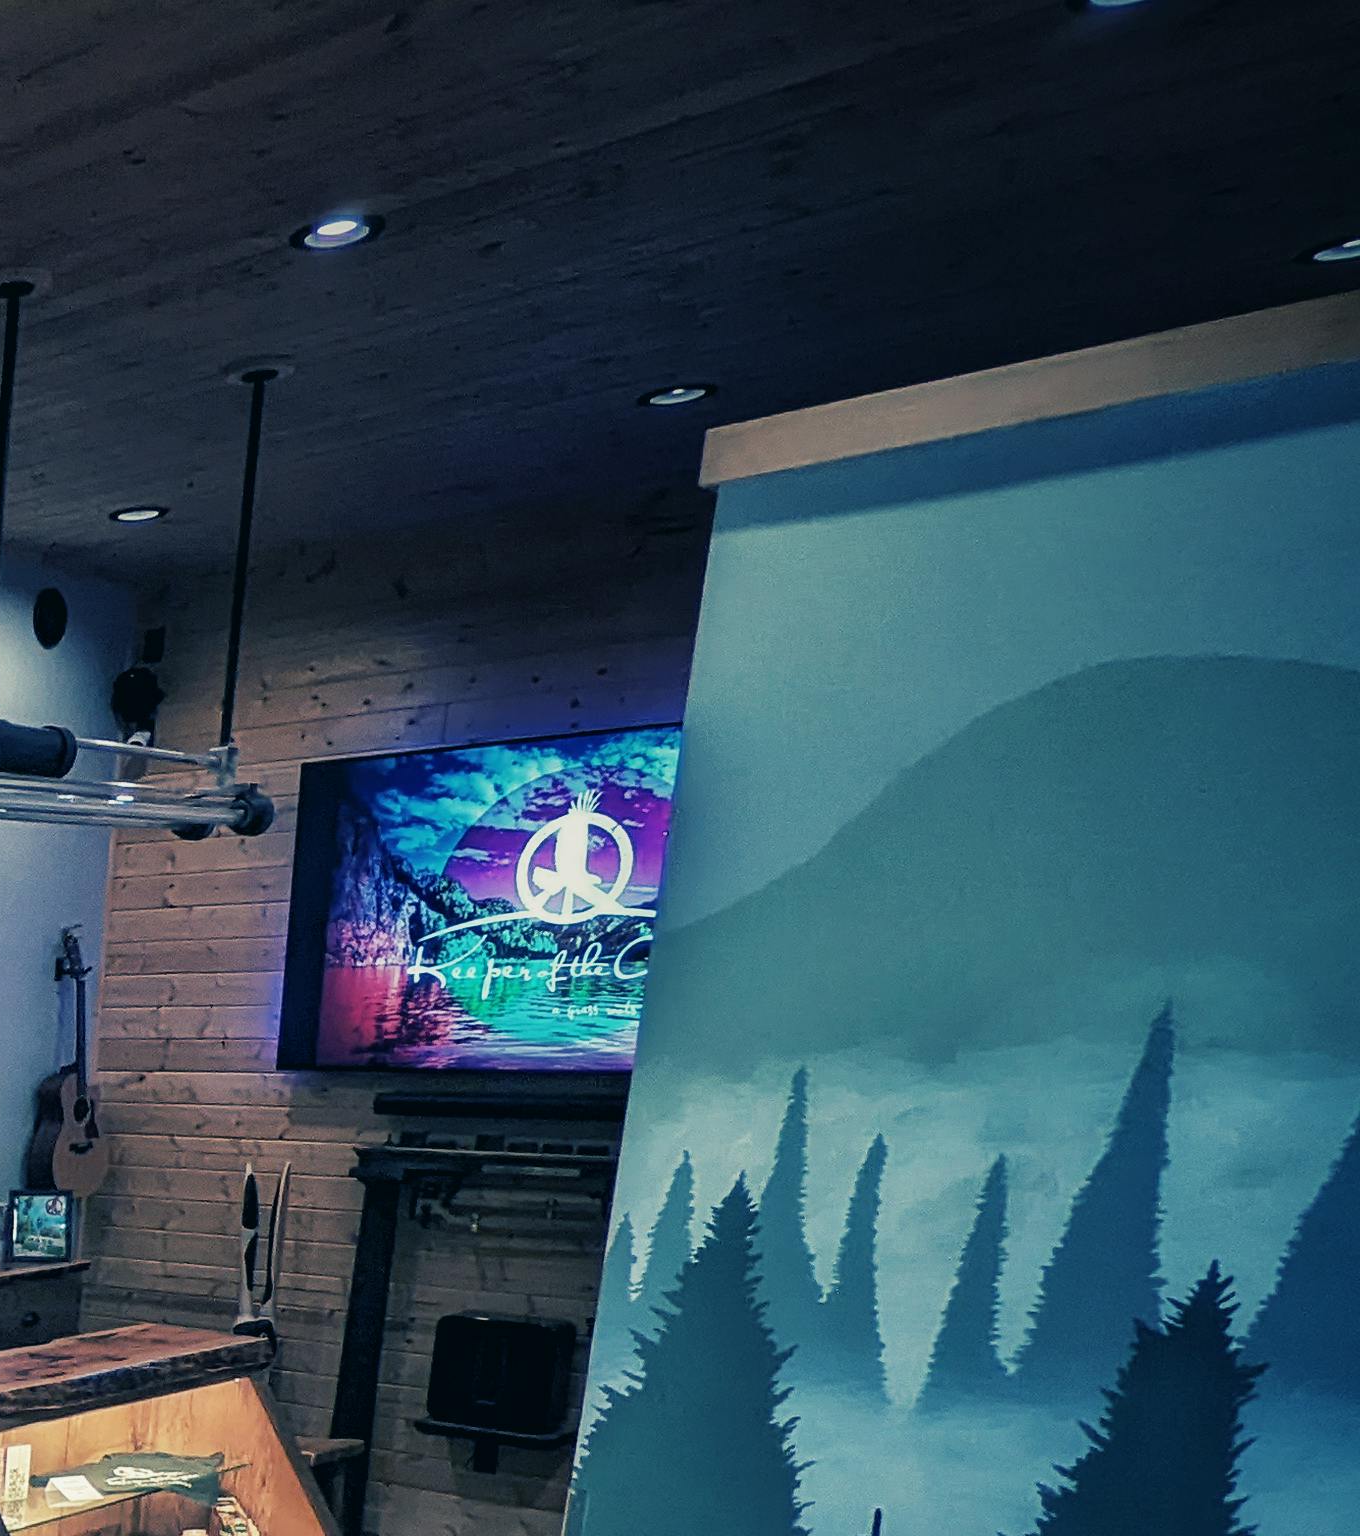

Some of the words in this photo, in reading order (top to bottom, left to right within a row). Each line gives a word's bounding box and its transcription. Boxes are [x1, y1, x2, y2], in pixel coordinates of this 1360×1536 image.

[406, 934, 533, 1001] Keeper
[536, 949, 570, 993] of
[566, 942, 611, 979] the
